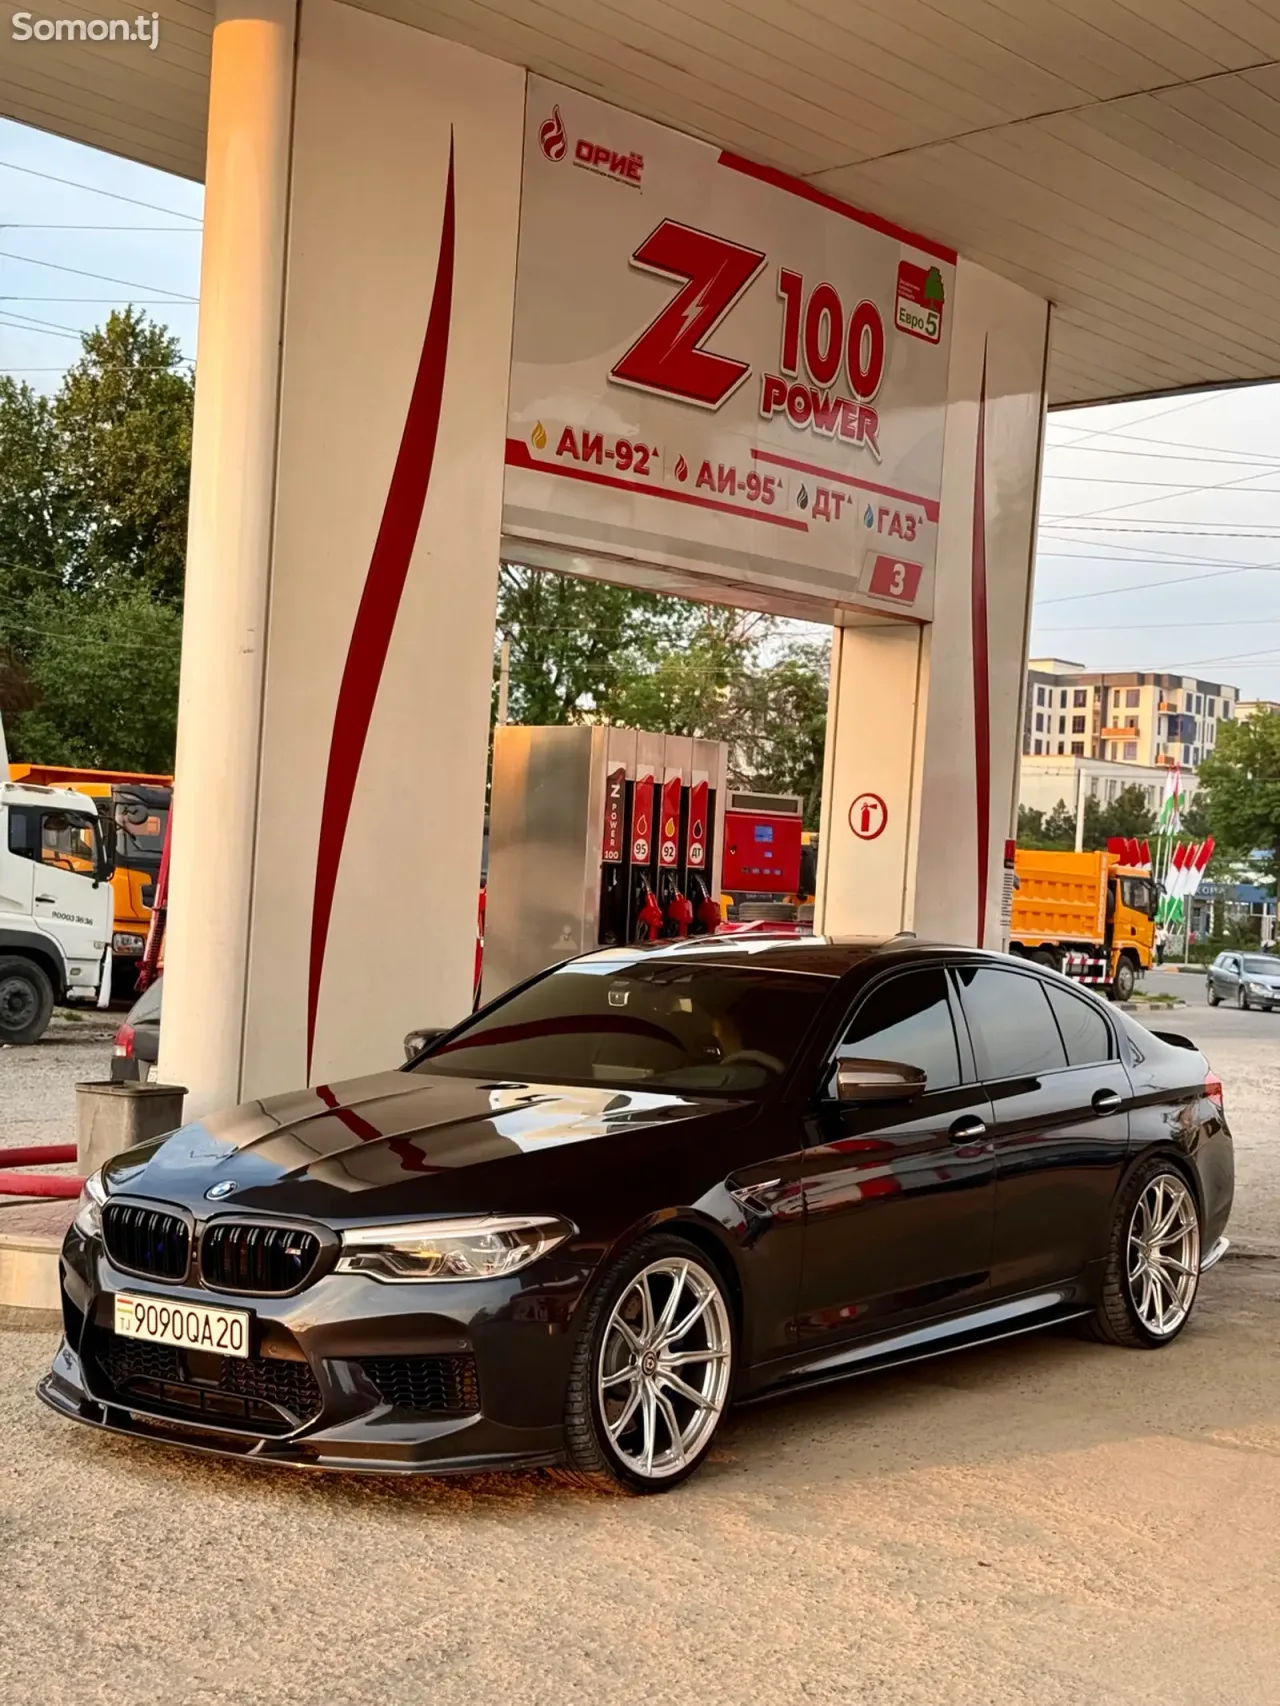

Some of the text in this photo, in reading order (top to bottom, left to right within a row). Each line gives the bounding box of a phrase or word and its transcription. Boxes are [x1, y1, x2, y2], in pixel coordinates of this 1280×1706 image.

[575, 139, 644, 183] ОРИЁ
[608, 217, 768, 411] Z
[898, 306, 939, 337] Евро 5
[777, 266, 885, 402] 100
[760, 373, 882, 463] POWER
[555, 425, 651, 476] АИ-92
[695, 459, 776, 506] АИ-95
[811, 485, 846, 522] ДТ
[876, 505, 917, 542] ГАЗ
[889, 563, 907, 596] 3
[610, 784, 621, 798] Z
[609, 803, 618, 847] POWER
[604, 850, 619, 860] 100
[635, 843, 647, 855] 95
[663, 846, 675, 857] 92
[691, 847, 702, 858] ДТ
[119, 1303, 243, 1350] TJ 9090QA20
